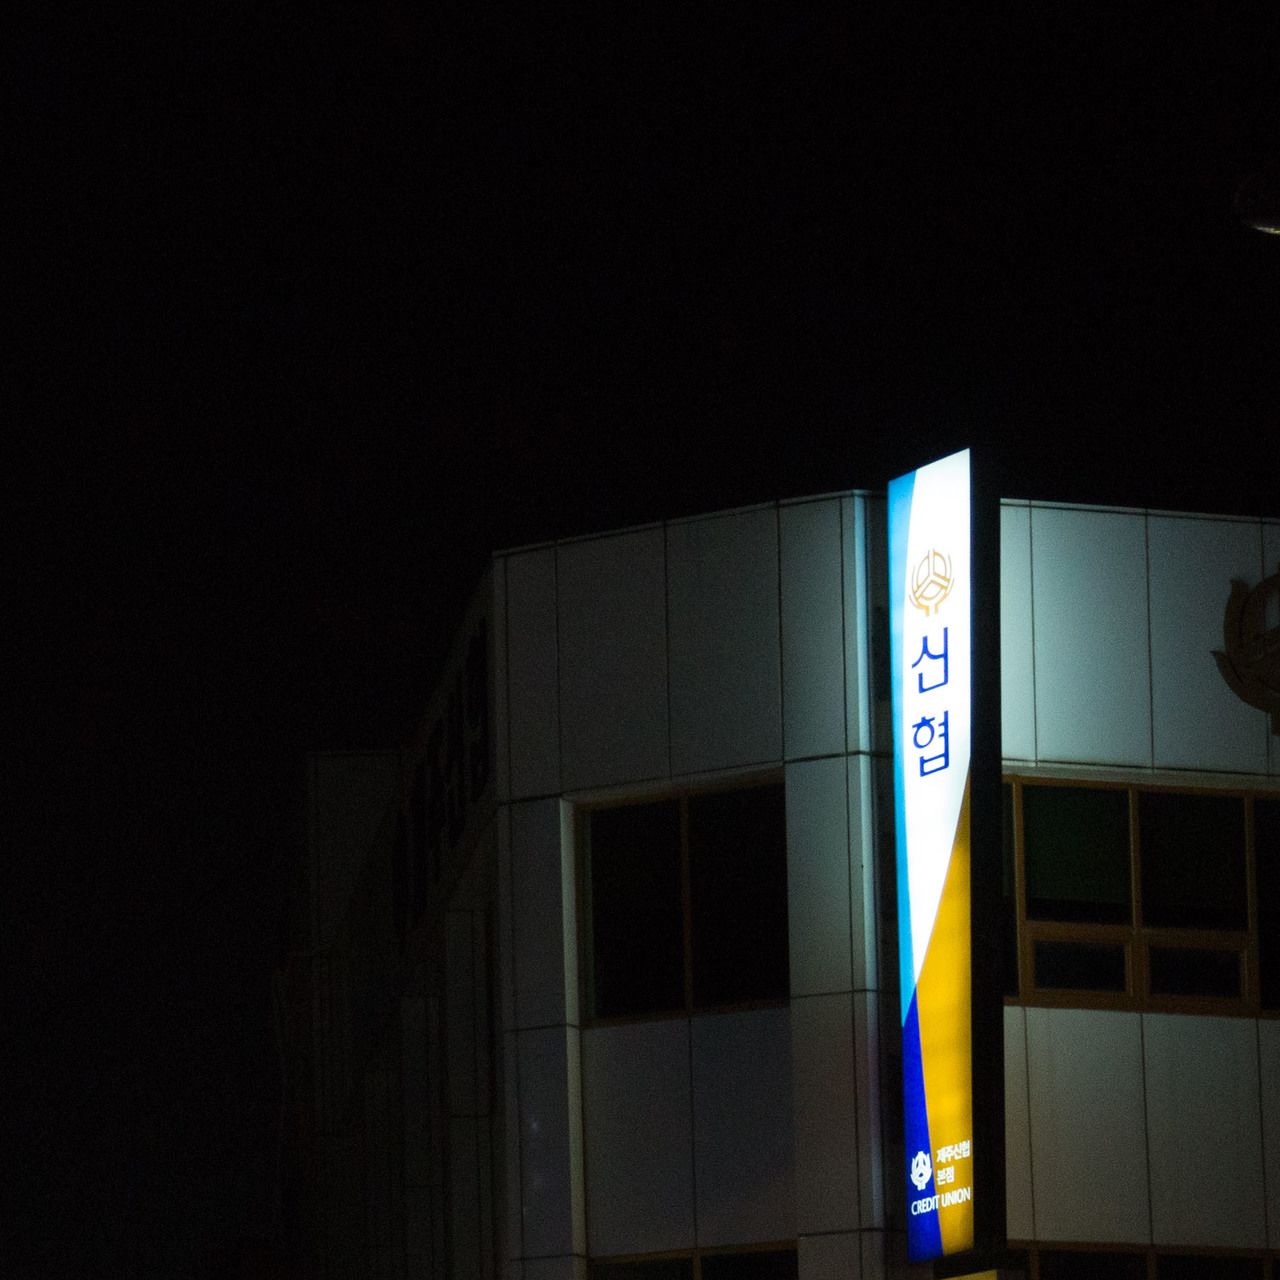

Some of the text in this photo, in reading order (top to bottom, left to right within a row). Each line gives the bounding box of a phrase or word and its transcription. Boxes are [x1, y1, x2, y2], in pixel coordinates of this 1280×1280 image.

[911, 626, 949, 777] 신협
[936, 1140, 970, 1164] 제주신협
[936, 1165, 955, 1185] 본점
[911, 1187, 971, 1216] CREDIT UNION
